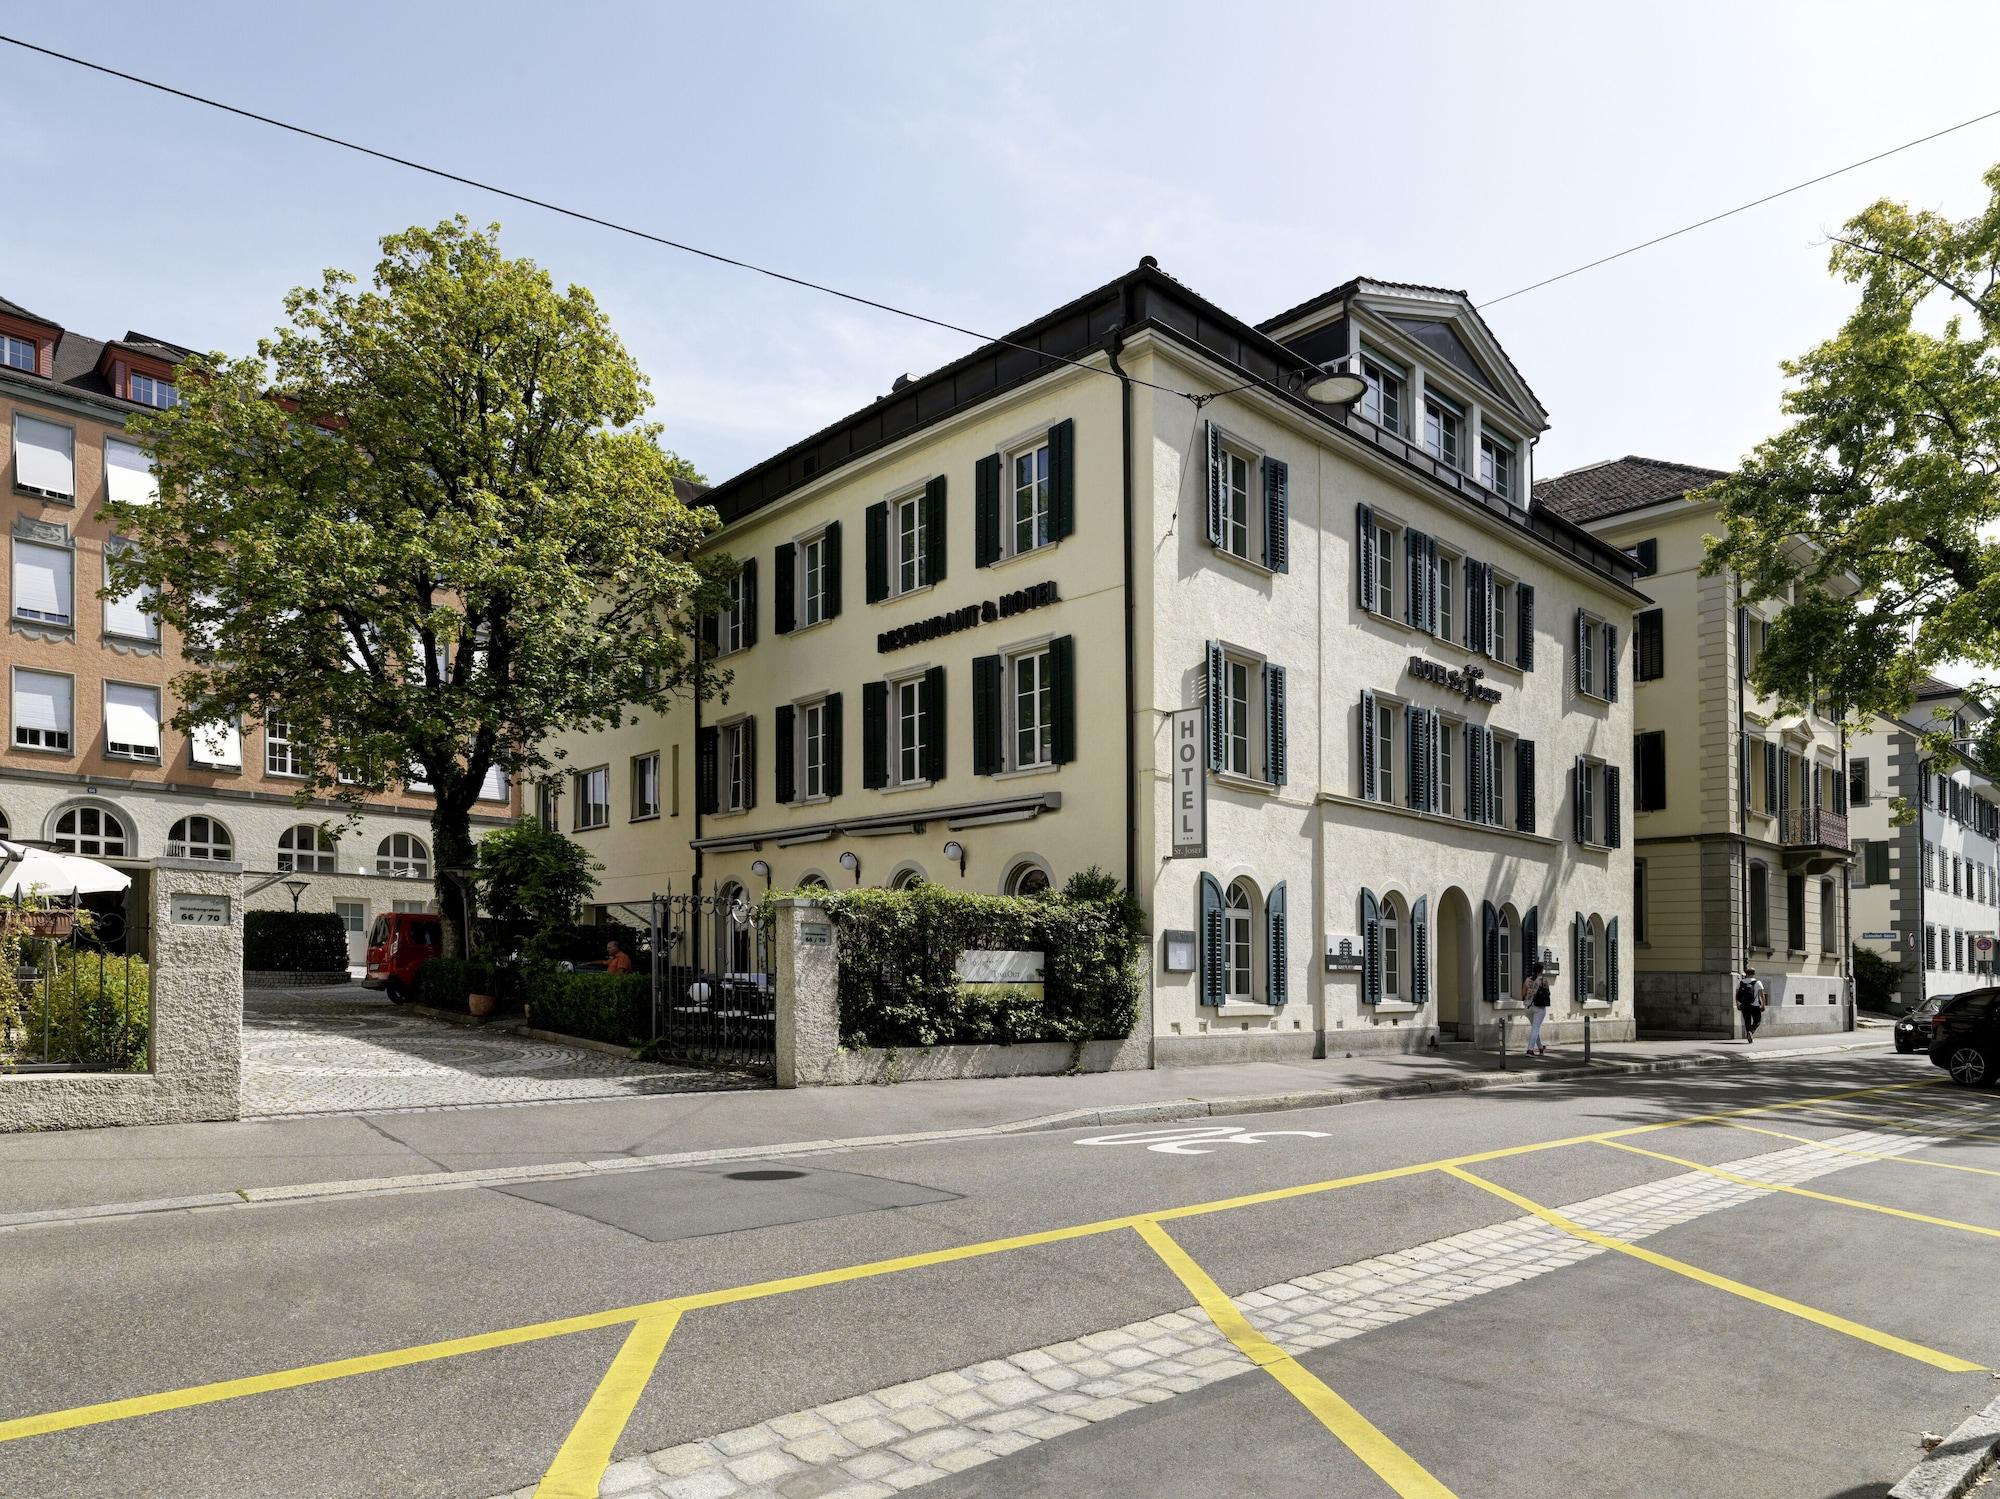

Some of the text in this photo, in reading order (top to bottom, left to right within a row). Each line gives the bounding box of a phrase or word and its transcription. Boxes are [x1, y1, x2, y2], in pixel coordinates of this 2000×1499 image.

[877, 581, 1061, 653] RESTAURANT & HOTEL
[1408, 656, 1448, 686] HOTEL
[1179, 719, 1195, 833] HOTEL
[181, 913, 220, 922] 66 / 70
